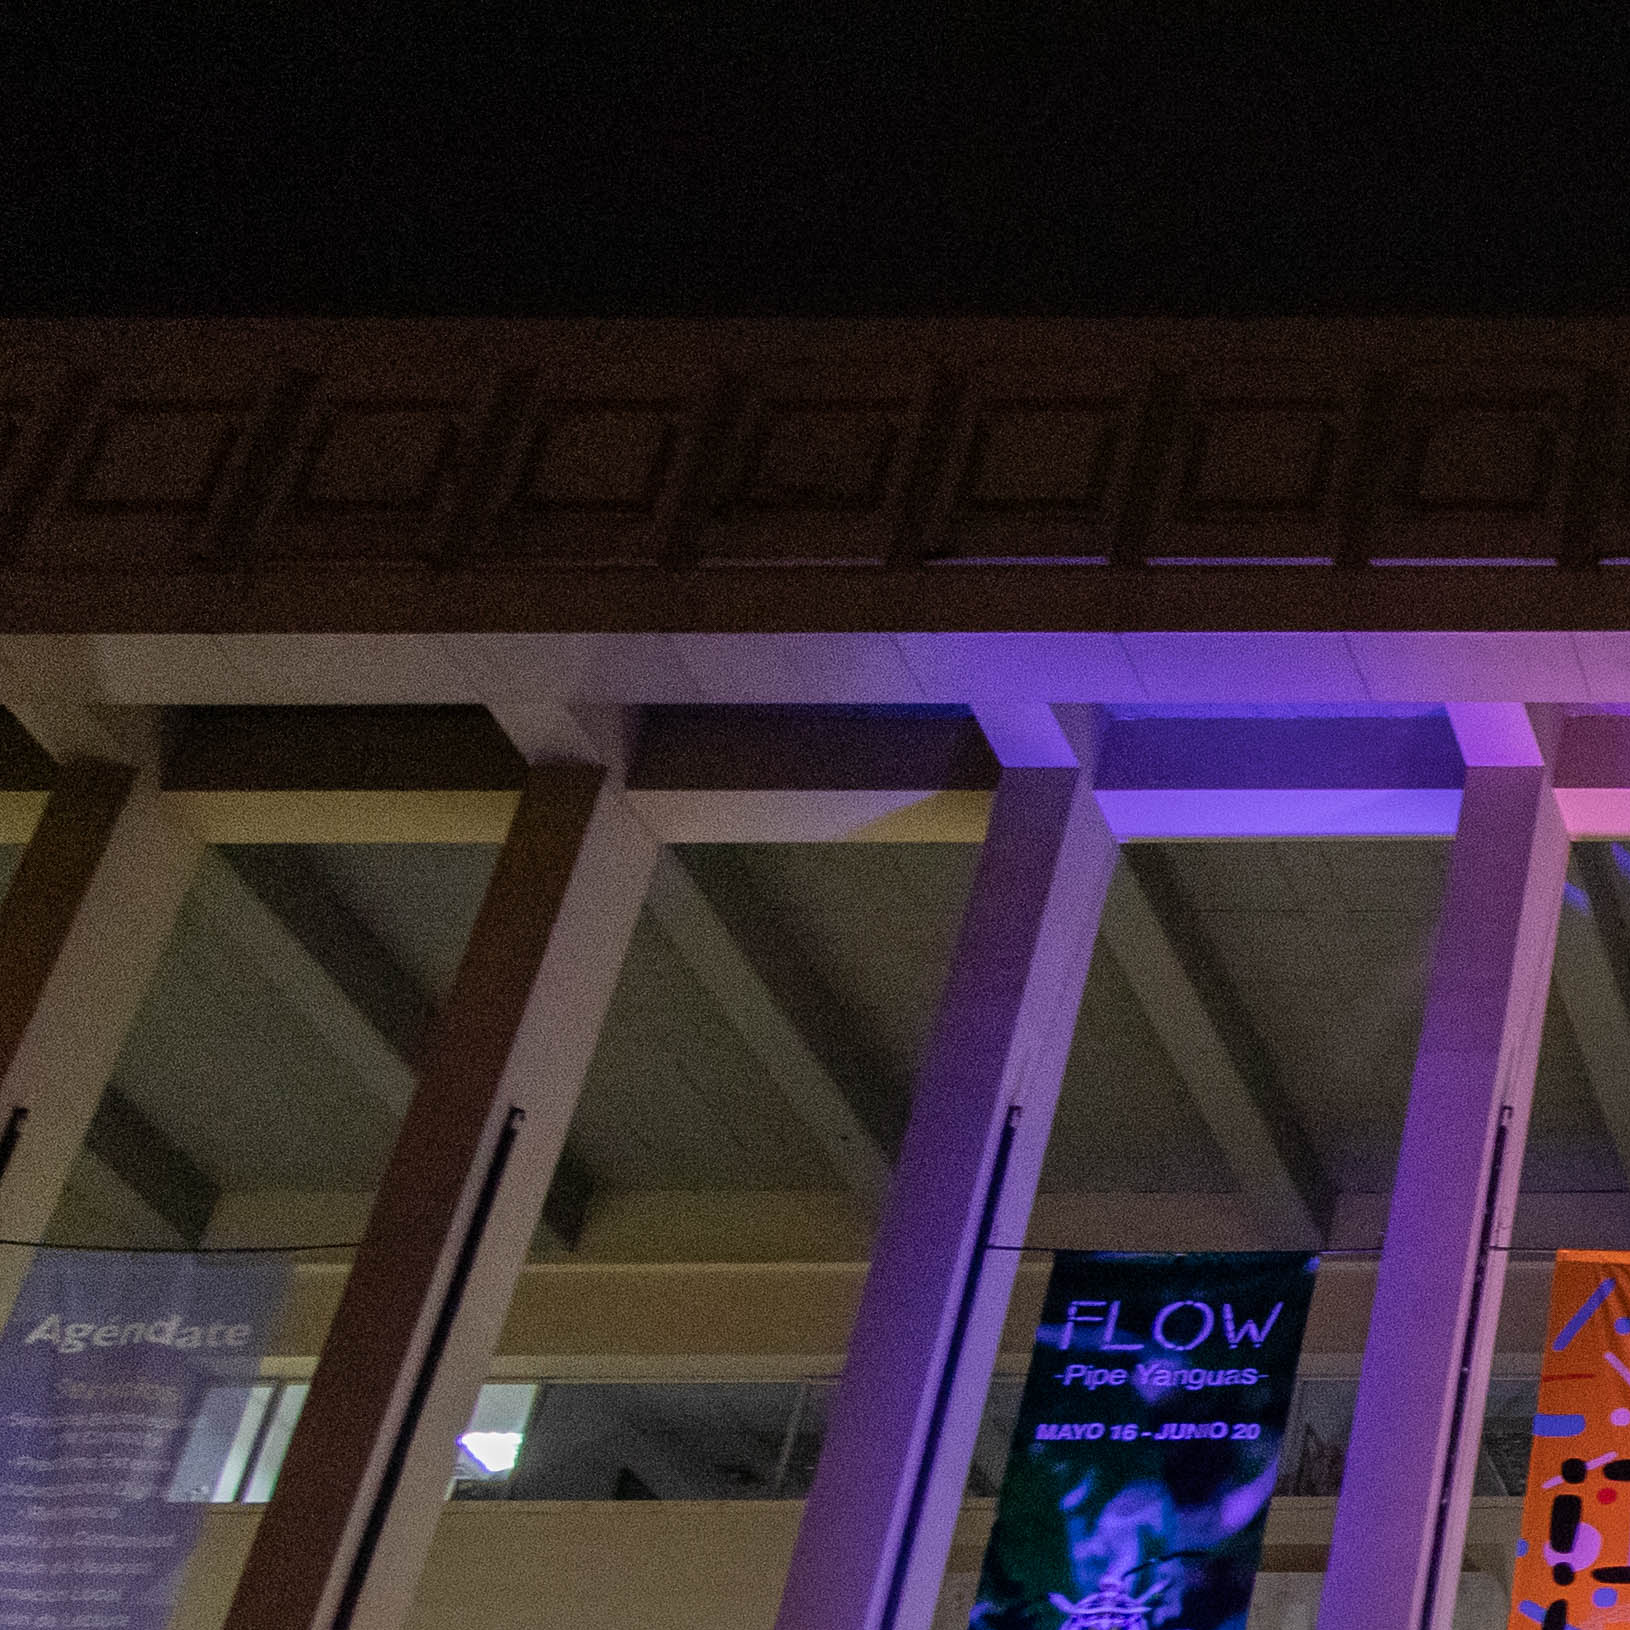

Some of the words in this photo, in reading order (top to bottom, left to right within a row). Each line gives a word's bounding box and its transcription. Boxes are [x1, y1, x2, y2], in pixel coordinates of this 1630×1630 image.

[1060, 1300, 1285, 1351] FLOW
[1035, 1423, 1105, 1441] MAYO
[1109, 1422, 1139, 1441] 16
[1155, 1421, 1230, 1441] JUNIO
[1231, 1422, 1262, 1440] 20
